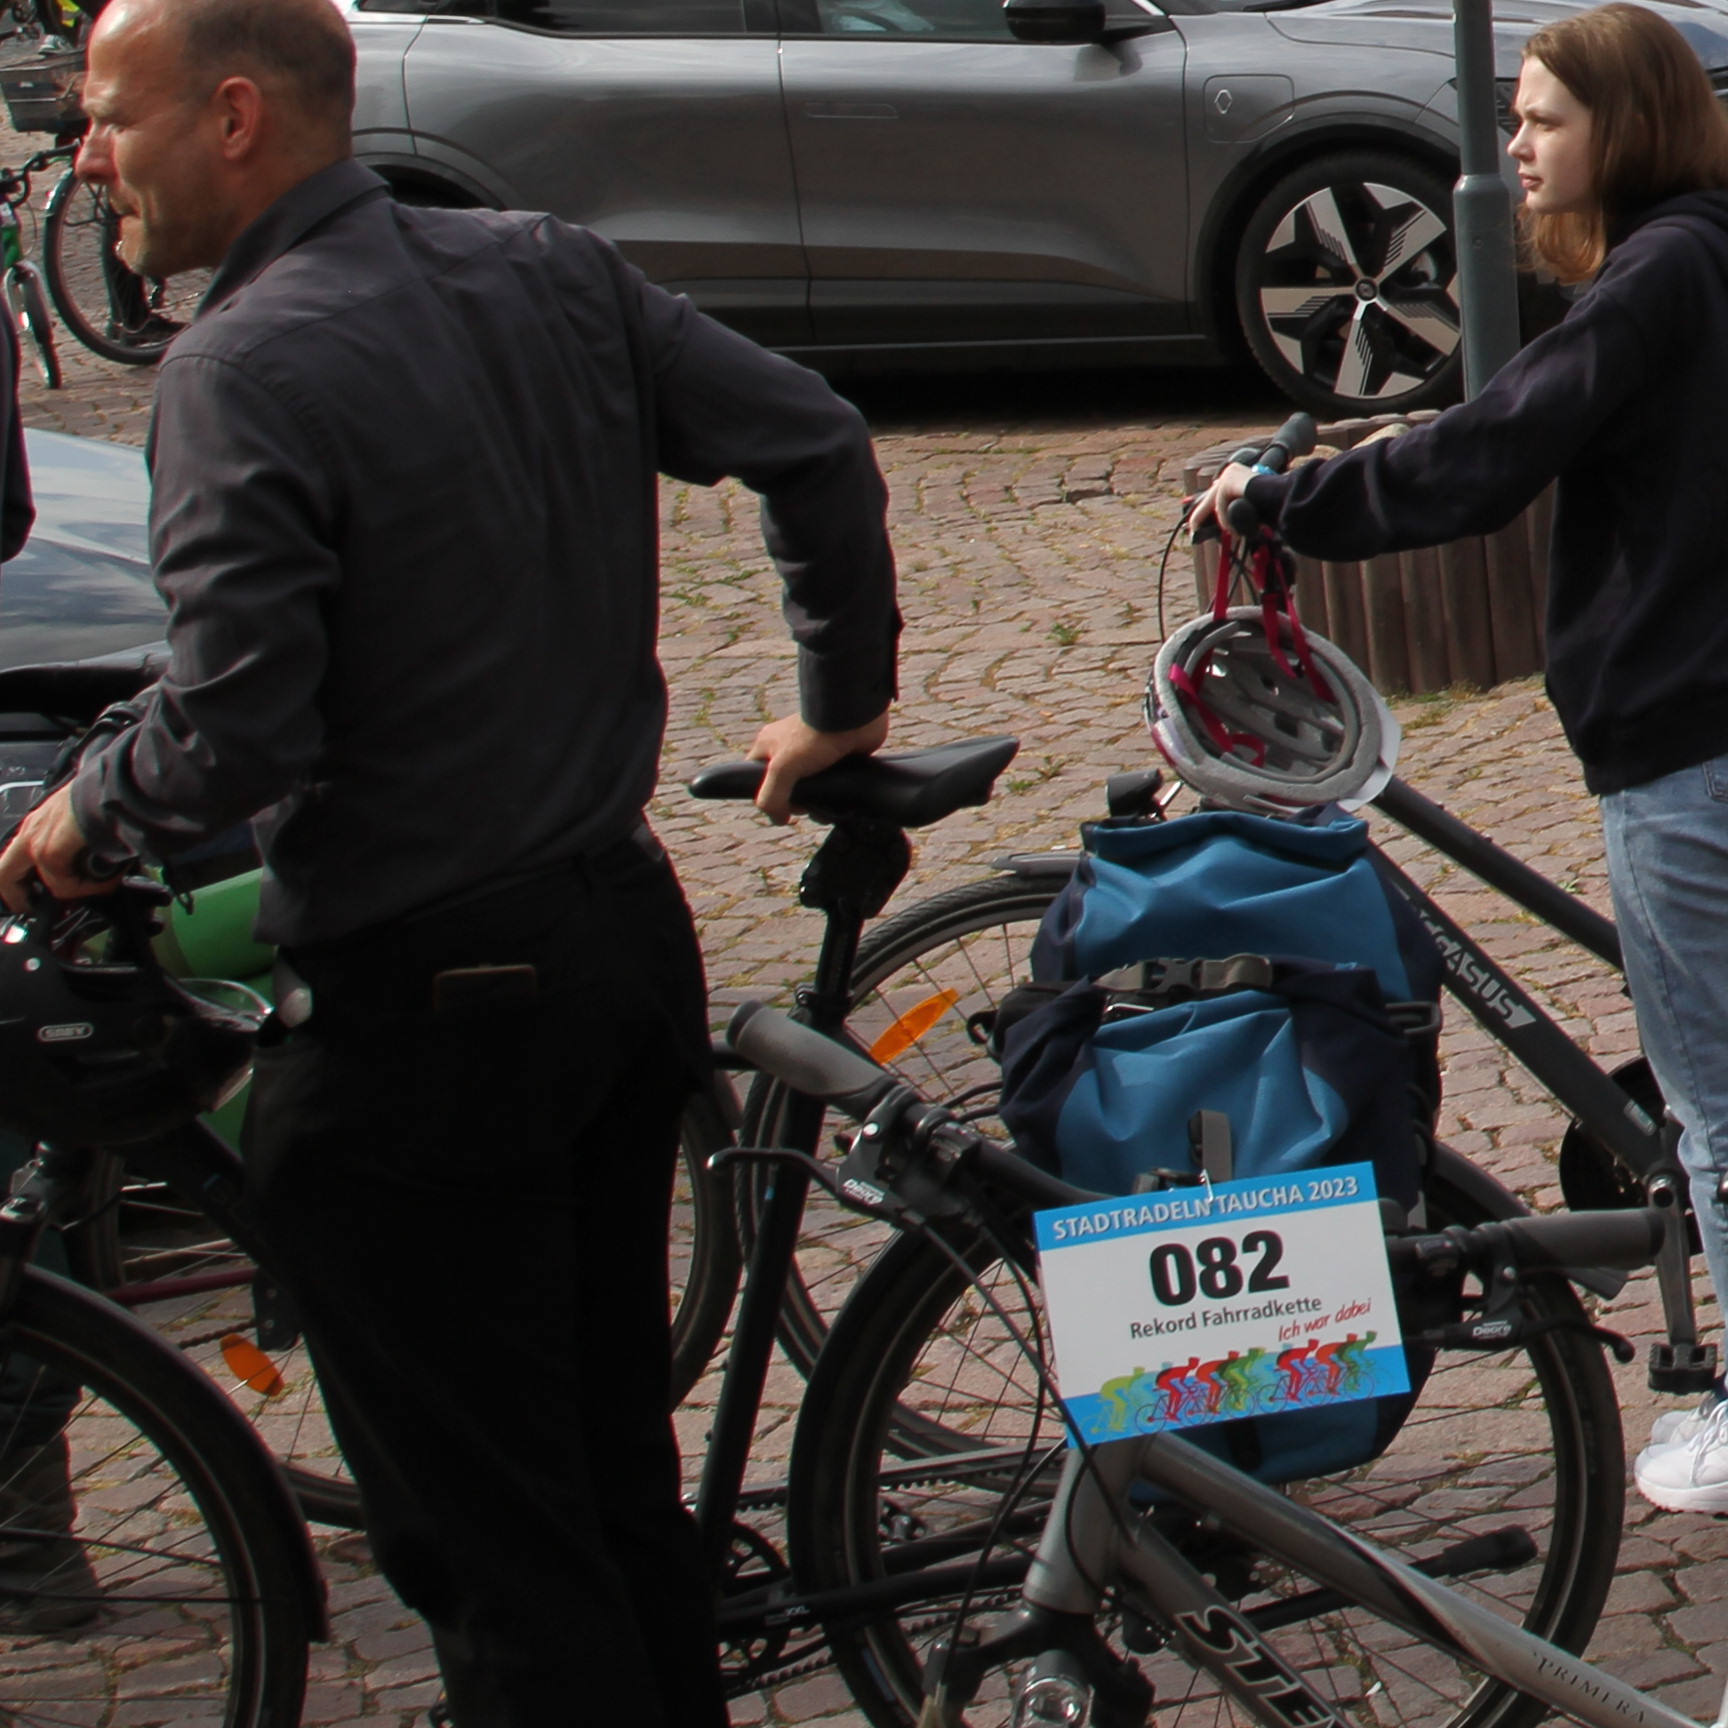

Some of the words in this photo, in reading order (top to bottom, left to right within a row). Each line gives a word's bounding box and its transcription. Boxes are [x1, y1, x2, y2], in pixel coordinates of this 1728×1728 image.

[1052, 1198, 1212, 1241] STADTRADELN
[1211, 1185, 1304, 1214] TAUCHA
[1307, 1176, 1359, 1203] 2023
[1149, 1229, 1290, 1306] 082
[1130, 1312, 1197, 1340] Rekord
[1202, 1296, 1322, 1328] Fahrradkette
[1278, 1323, 1300, 1342] Ich
[1302, 1313, 1329, 1332] war
[1334, 1298, 1372, 1325] dabei
